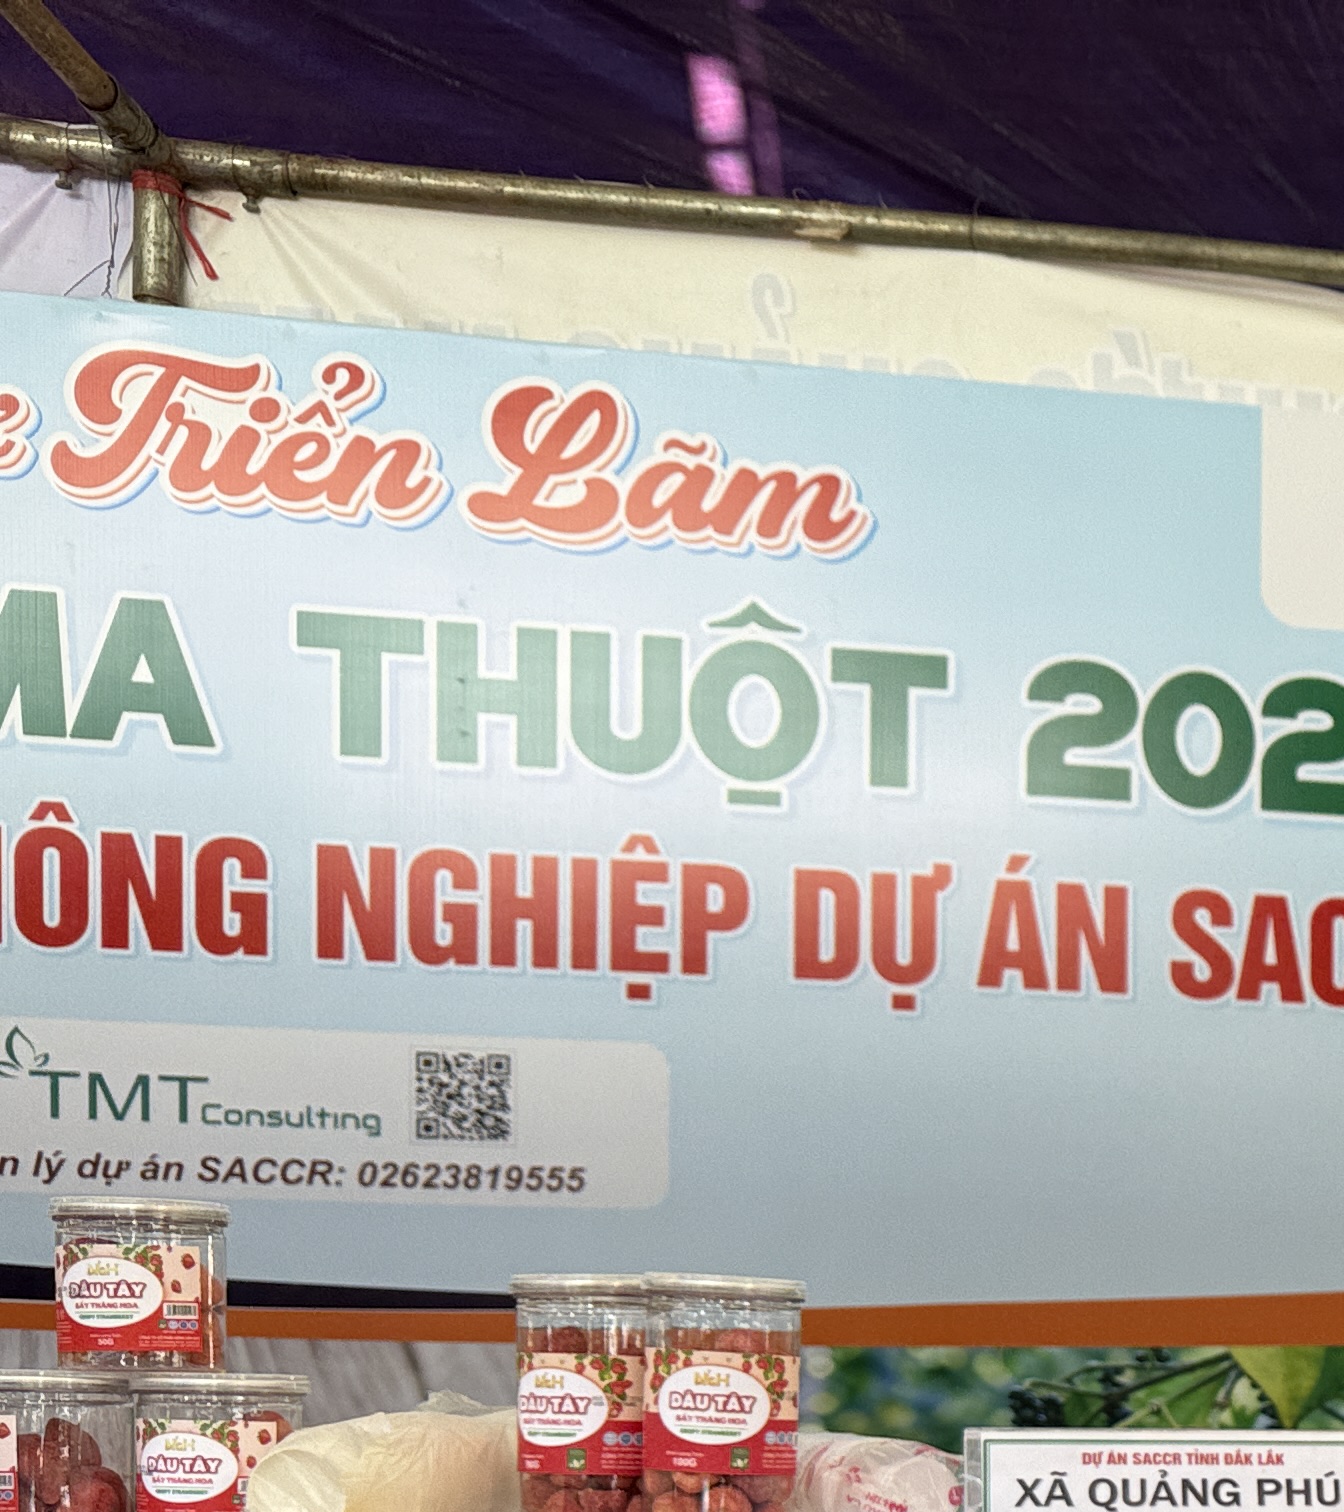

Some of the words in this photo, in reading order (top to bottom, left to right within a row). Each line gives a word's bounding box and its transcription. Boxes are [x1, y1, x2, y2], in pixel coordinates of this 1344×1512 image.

[48, 343, 447, 524] Triển
[464, 382, 875, 558] Lãm
[294, 600, 952, 807] THUỘT
[0, 800, 270, 958] ÔNG
[315, 833, 751, 1000] NGHIỆP
[792, 861, 954, 1012] DỰ
[976, 854, 1130, 995] ÁN
[28, 1069, 209, 1125] TMT
[201, 1103, 381, 1136] Consulting
[33, 1149, 66, 1182] lý
[77, 1152, 132, 1188] dự
[140, 1153, 184, 1183] án
[197, 1156, 344, 1188] SACCR:
[357, 1160, 588, 1194] 02623819555
[1014, 1471, 1074, 1508] XÃ
[1088, 1469, 1242, 1512] QUẢNG
[1256, 1470, 1342, 1507] PHÚ
[1132, 1452, 1182, 1465] SACCR
[1186, 1448, 1220, 1466] TỈNH
